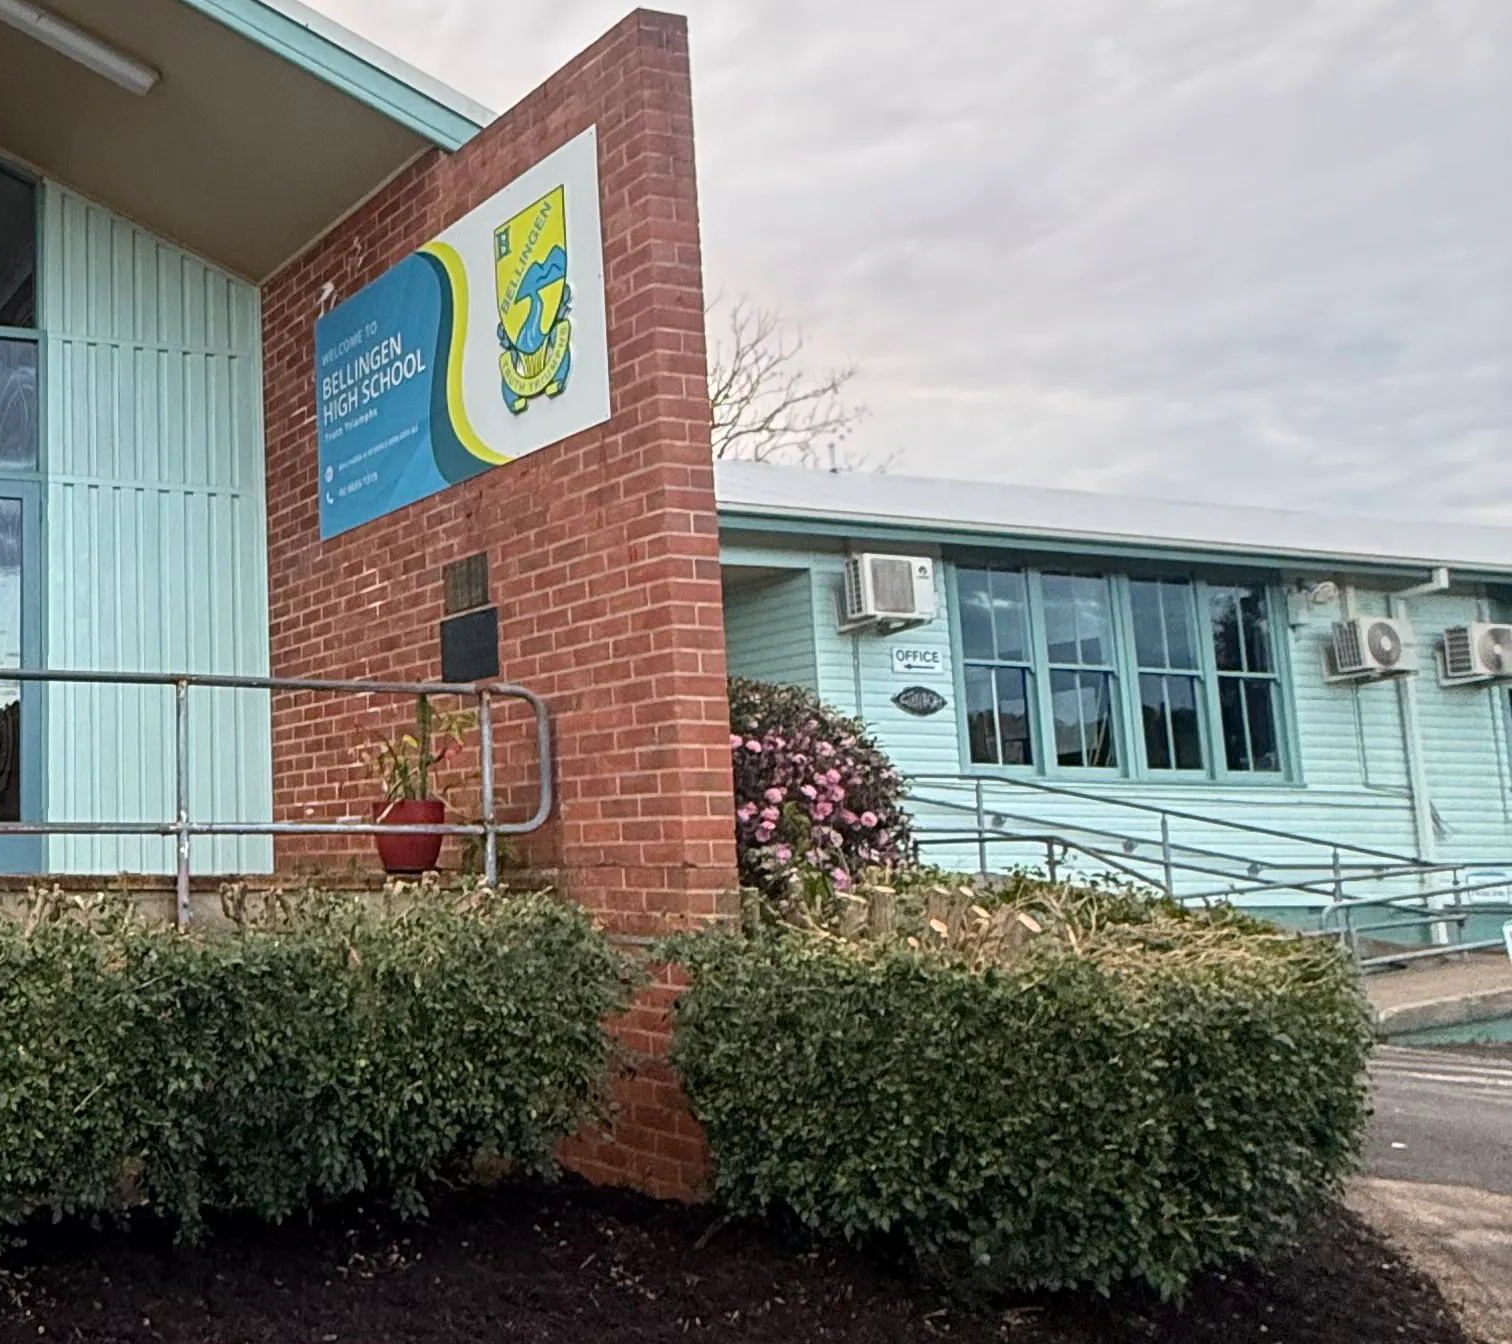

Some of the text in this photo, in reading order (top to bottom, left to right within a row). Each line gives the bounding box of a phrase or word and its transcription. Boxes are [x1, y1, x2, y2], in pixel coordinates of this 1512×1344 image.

[501, 201, 553, 315] BELLINGEN
[321, 320, 378, 366] WELCOME TO
[322, 332, 402, 400] BELLINGEN
[323, 348, 426, 426] HIGH SCHOOL
[895, 649, 941, 664] OFFICE
